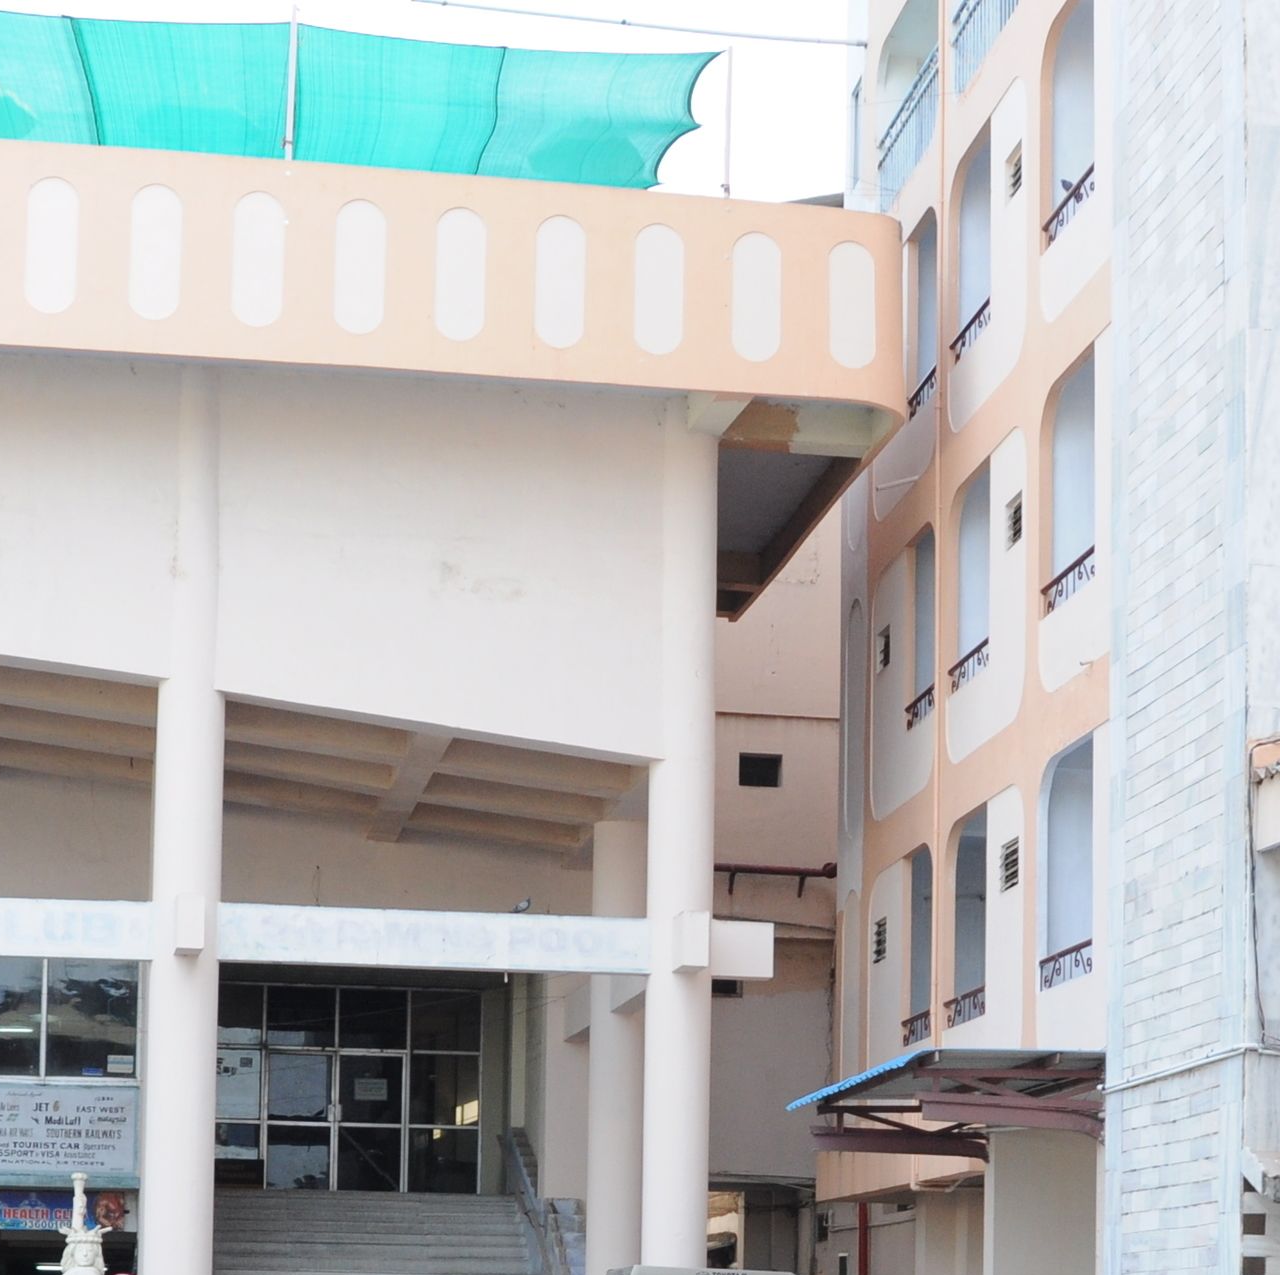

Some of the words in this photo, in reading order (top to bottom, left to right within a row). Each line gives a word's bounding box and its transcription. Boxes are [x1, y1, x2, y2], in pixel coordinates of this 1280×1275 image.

[32, 1102, 49, 1112] JET
[76, 1106, 96, 1114] EAST
[99, 1106, 126, 1115] WEST
[46, 1128, 82, 1139] SOUTHERN
[85, 1128, 122, 1140] RAILWAYS
[13, 1141, 57, 1149] TOURIST
[59, 1142, 80, 1150] CAR
[41, 1150, 60, 1158] VISA
[3, 1207, 50, 1220] HEALTH
